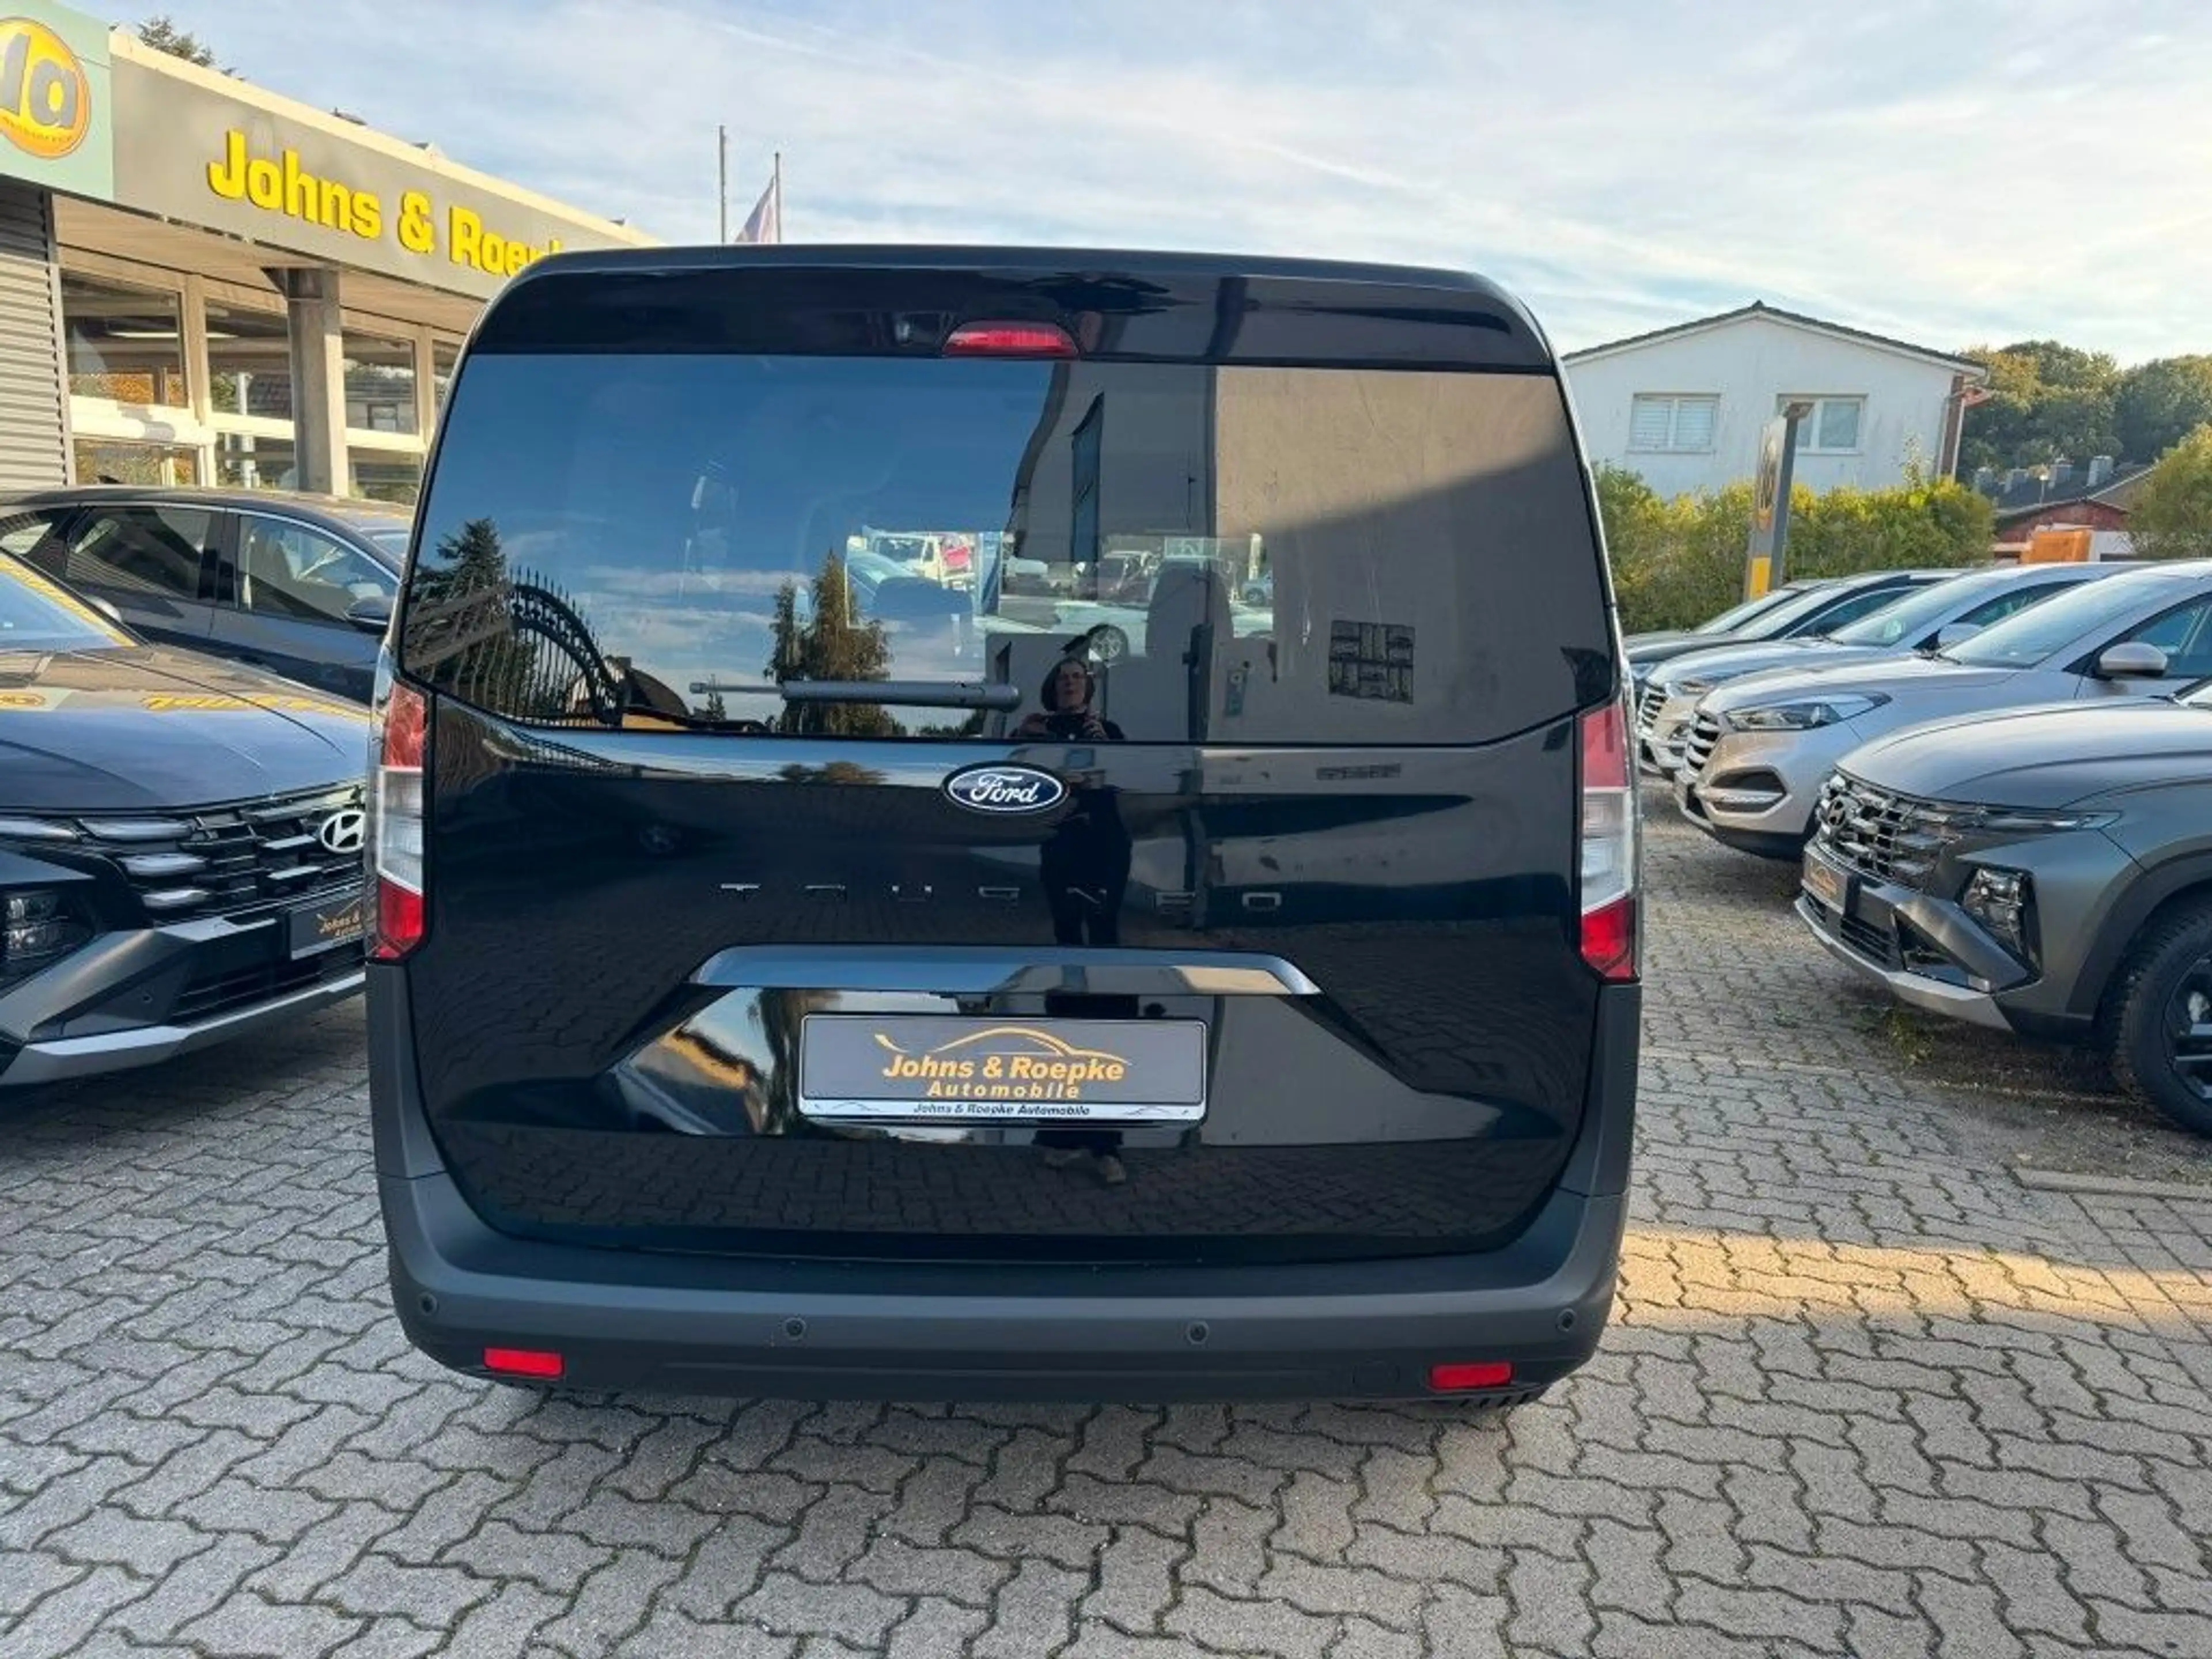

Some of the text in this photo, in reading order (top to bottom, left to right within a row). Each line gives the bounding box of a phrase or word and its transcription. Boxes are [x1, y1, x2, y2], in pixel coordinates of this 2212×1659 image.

[207, 130, 381, 239] Johns
[398, 190, 435, 253] &
[970, 772, 1040, 803] Ford
[882, 1055, 1124, 1084] Johns & Roepke
[927, 1081, 1081, 1099] Automobile
[914, 1104, 951, 1113] Johns
[967, 1104, 1014, 1115] Roepke
[1017, 1104, 1090, 1115] Automobile
